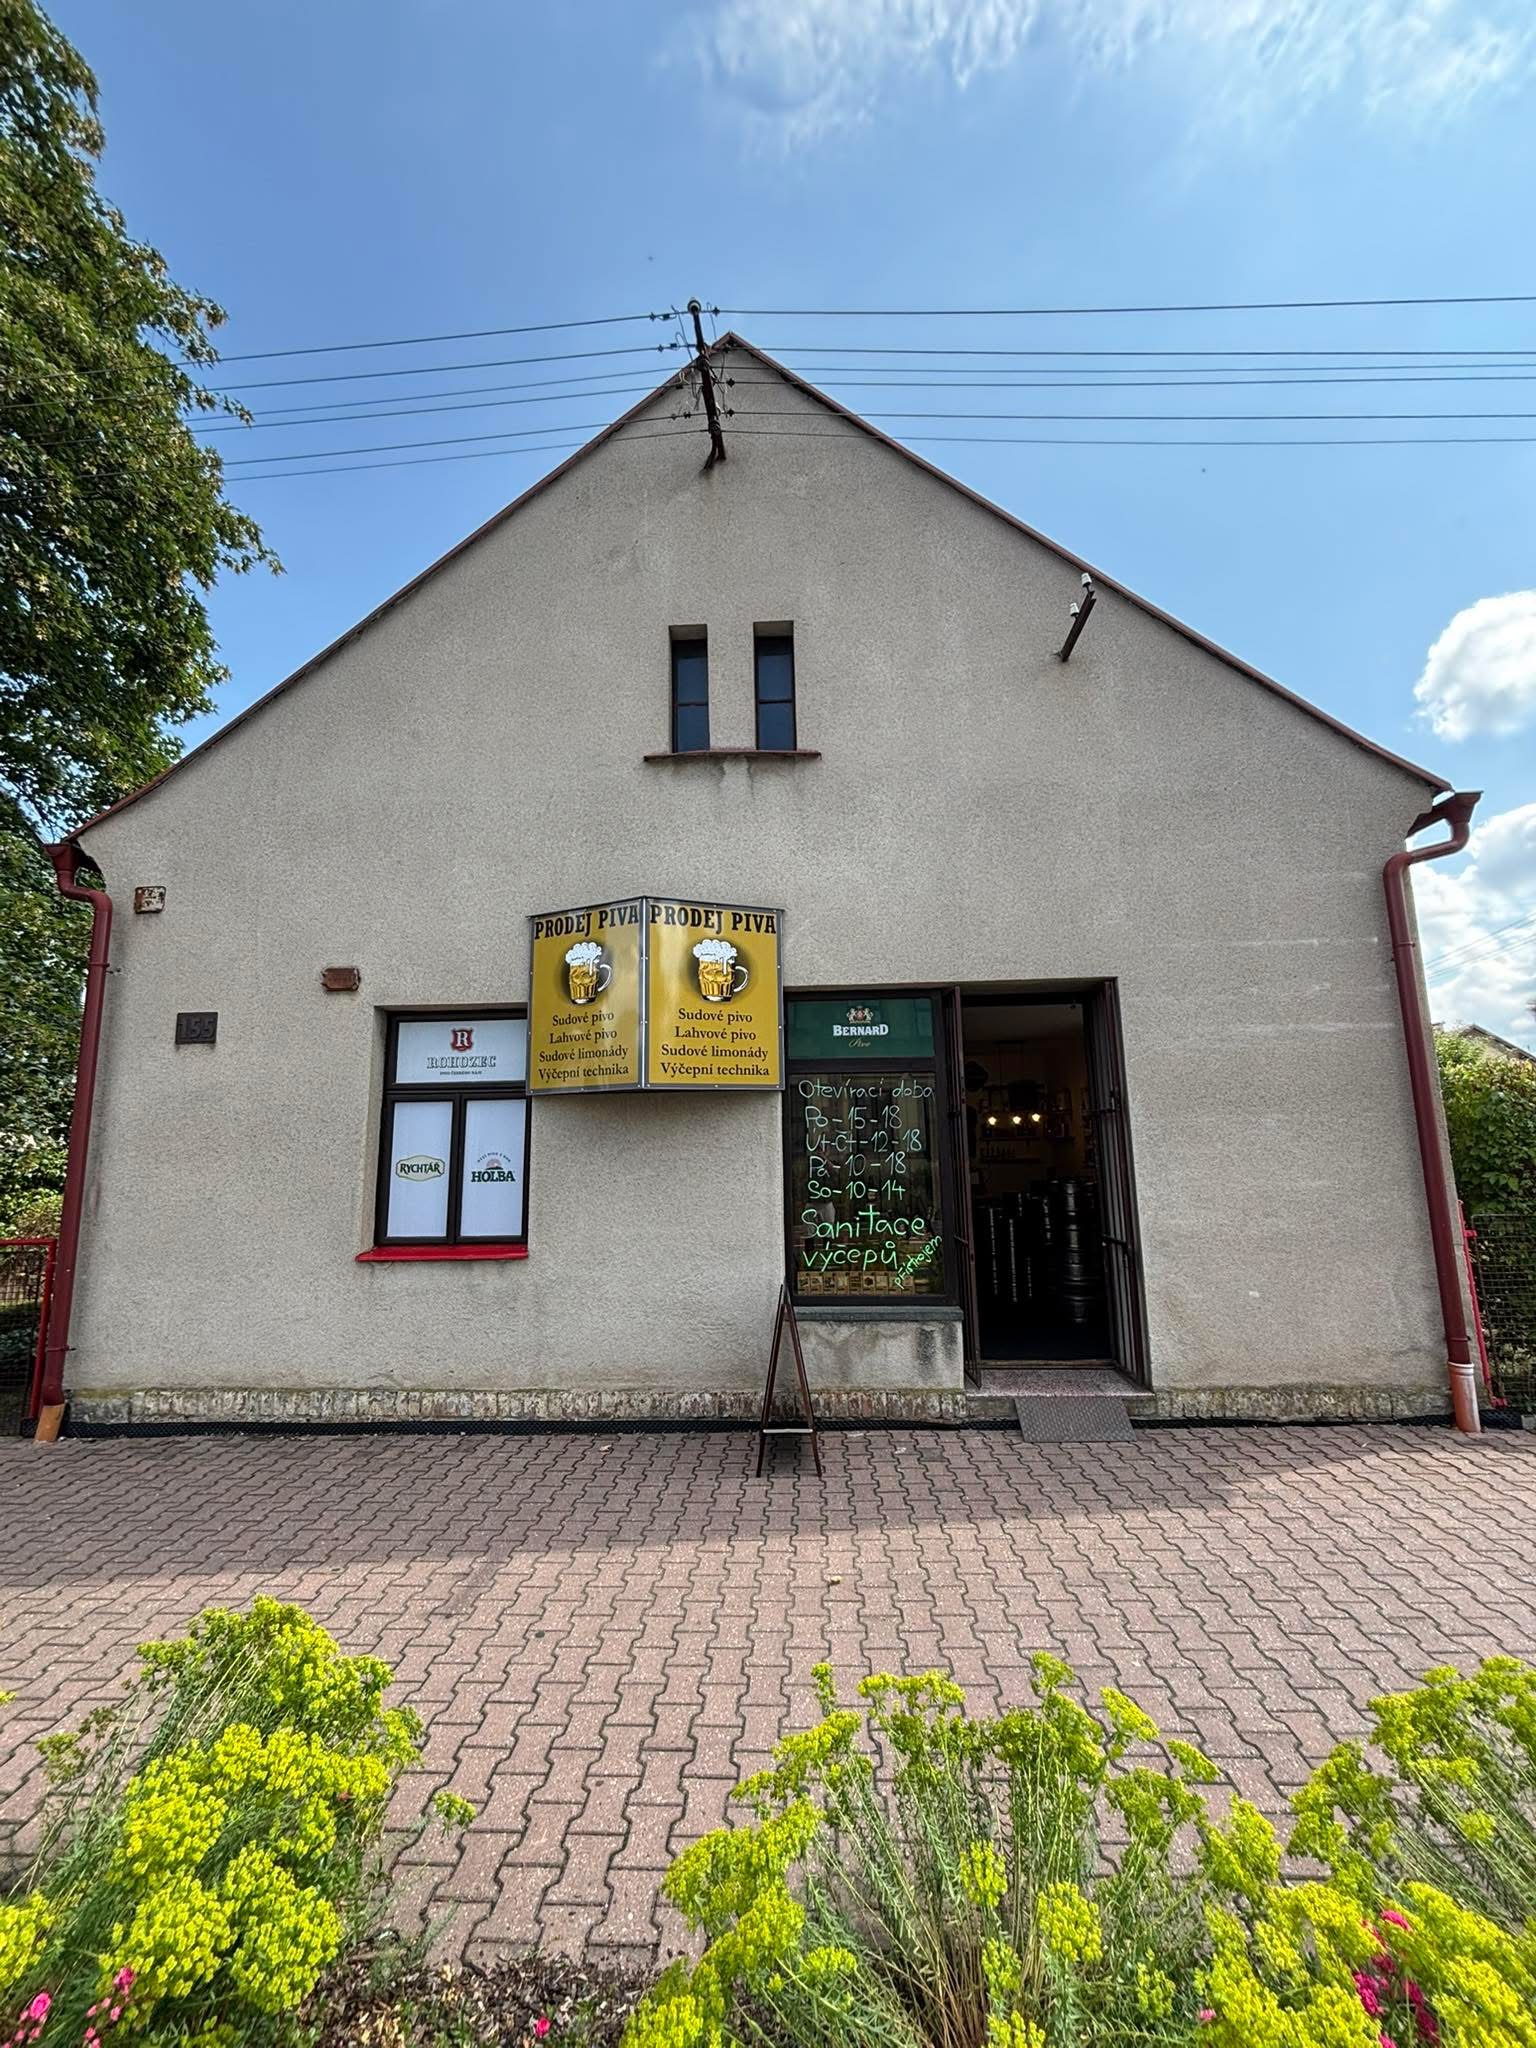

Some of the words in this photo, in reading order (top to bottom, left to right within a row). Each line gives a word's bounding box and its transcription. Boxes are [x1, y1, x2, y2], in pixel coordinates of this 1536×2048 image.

[534, 912, 592, 939] PRODEJ
[598, 904, 640, 929] PIVA
[650, 904, 723, 934] PRODEJ
[731, 912, 777, 934] PIVA
[552, 1011, 589, 1026] Sudové
[591, 1010, 614, 1026] pivo
[678, 1008, 724, 1022] Sudové
[727, 1010, 753, 1025] pivo
[455, 1031, 469, 1047] R
[550, 1029, 591, 1044] Lahvové
[594, 1028, 617, 1043] pivo
[675, 1026, 727, 1039] Lahvové
[731, 1028, 756, 1043] pivo
[832, 1024, 889, 1037] BERNARD
[539, 1048, 576, 1063] Sudové
[578, 1045, 629, 1060] limonády
[661, 1044, 708, 1057] Sudové
[711, 1045, 769, 1062] limonády
[427, 1055, 496, 1069] ROHOZEC
[661, 1062, 713, 1079] Výčepní
[717, 1064, 770, 1076] technika
[538, 1065, 580, 1083] Výčepní
[583, 1062, 629, 1078] technika
[891, 1079, 936, 1101] doba
[400, 1162, 440, 1175] RYCHTÁŘ
[471, 1170, 516, 1182] HOLBA
[801, 1204, 925, 1239] Sanitace
[802, 1241, 898, 1272] výčepů
